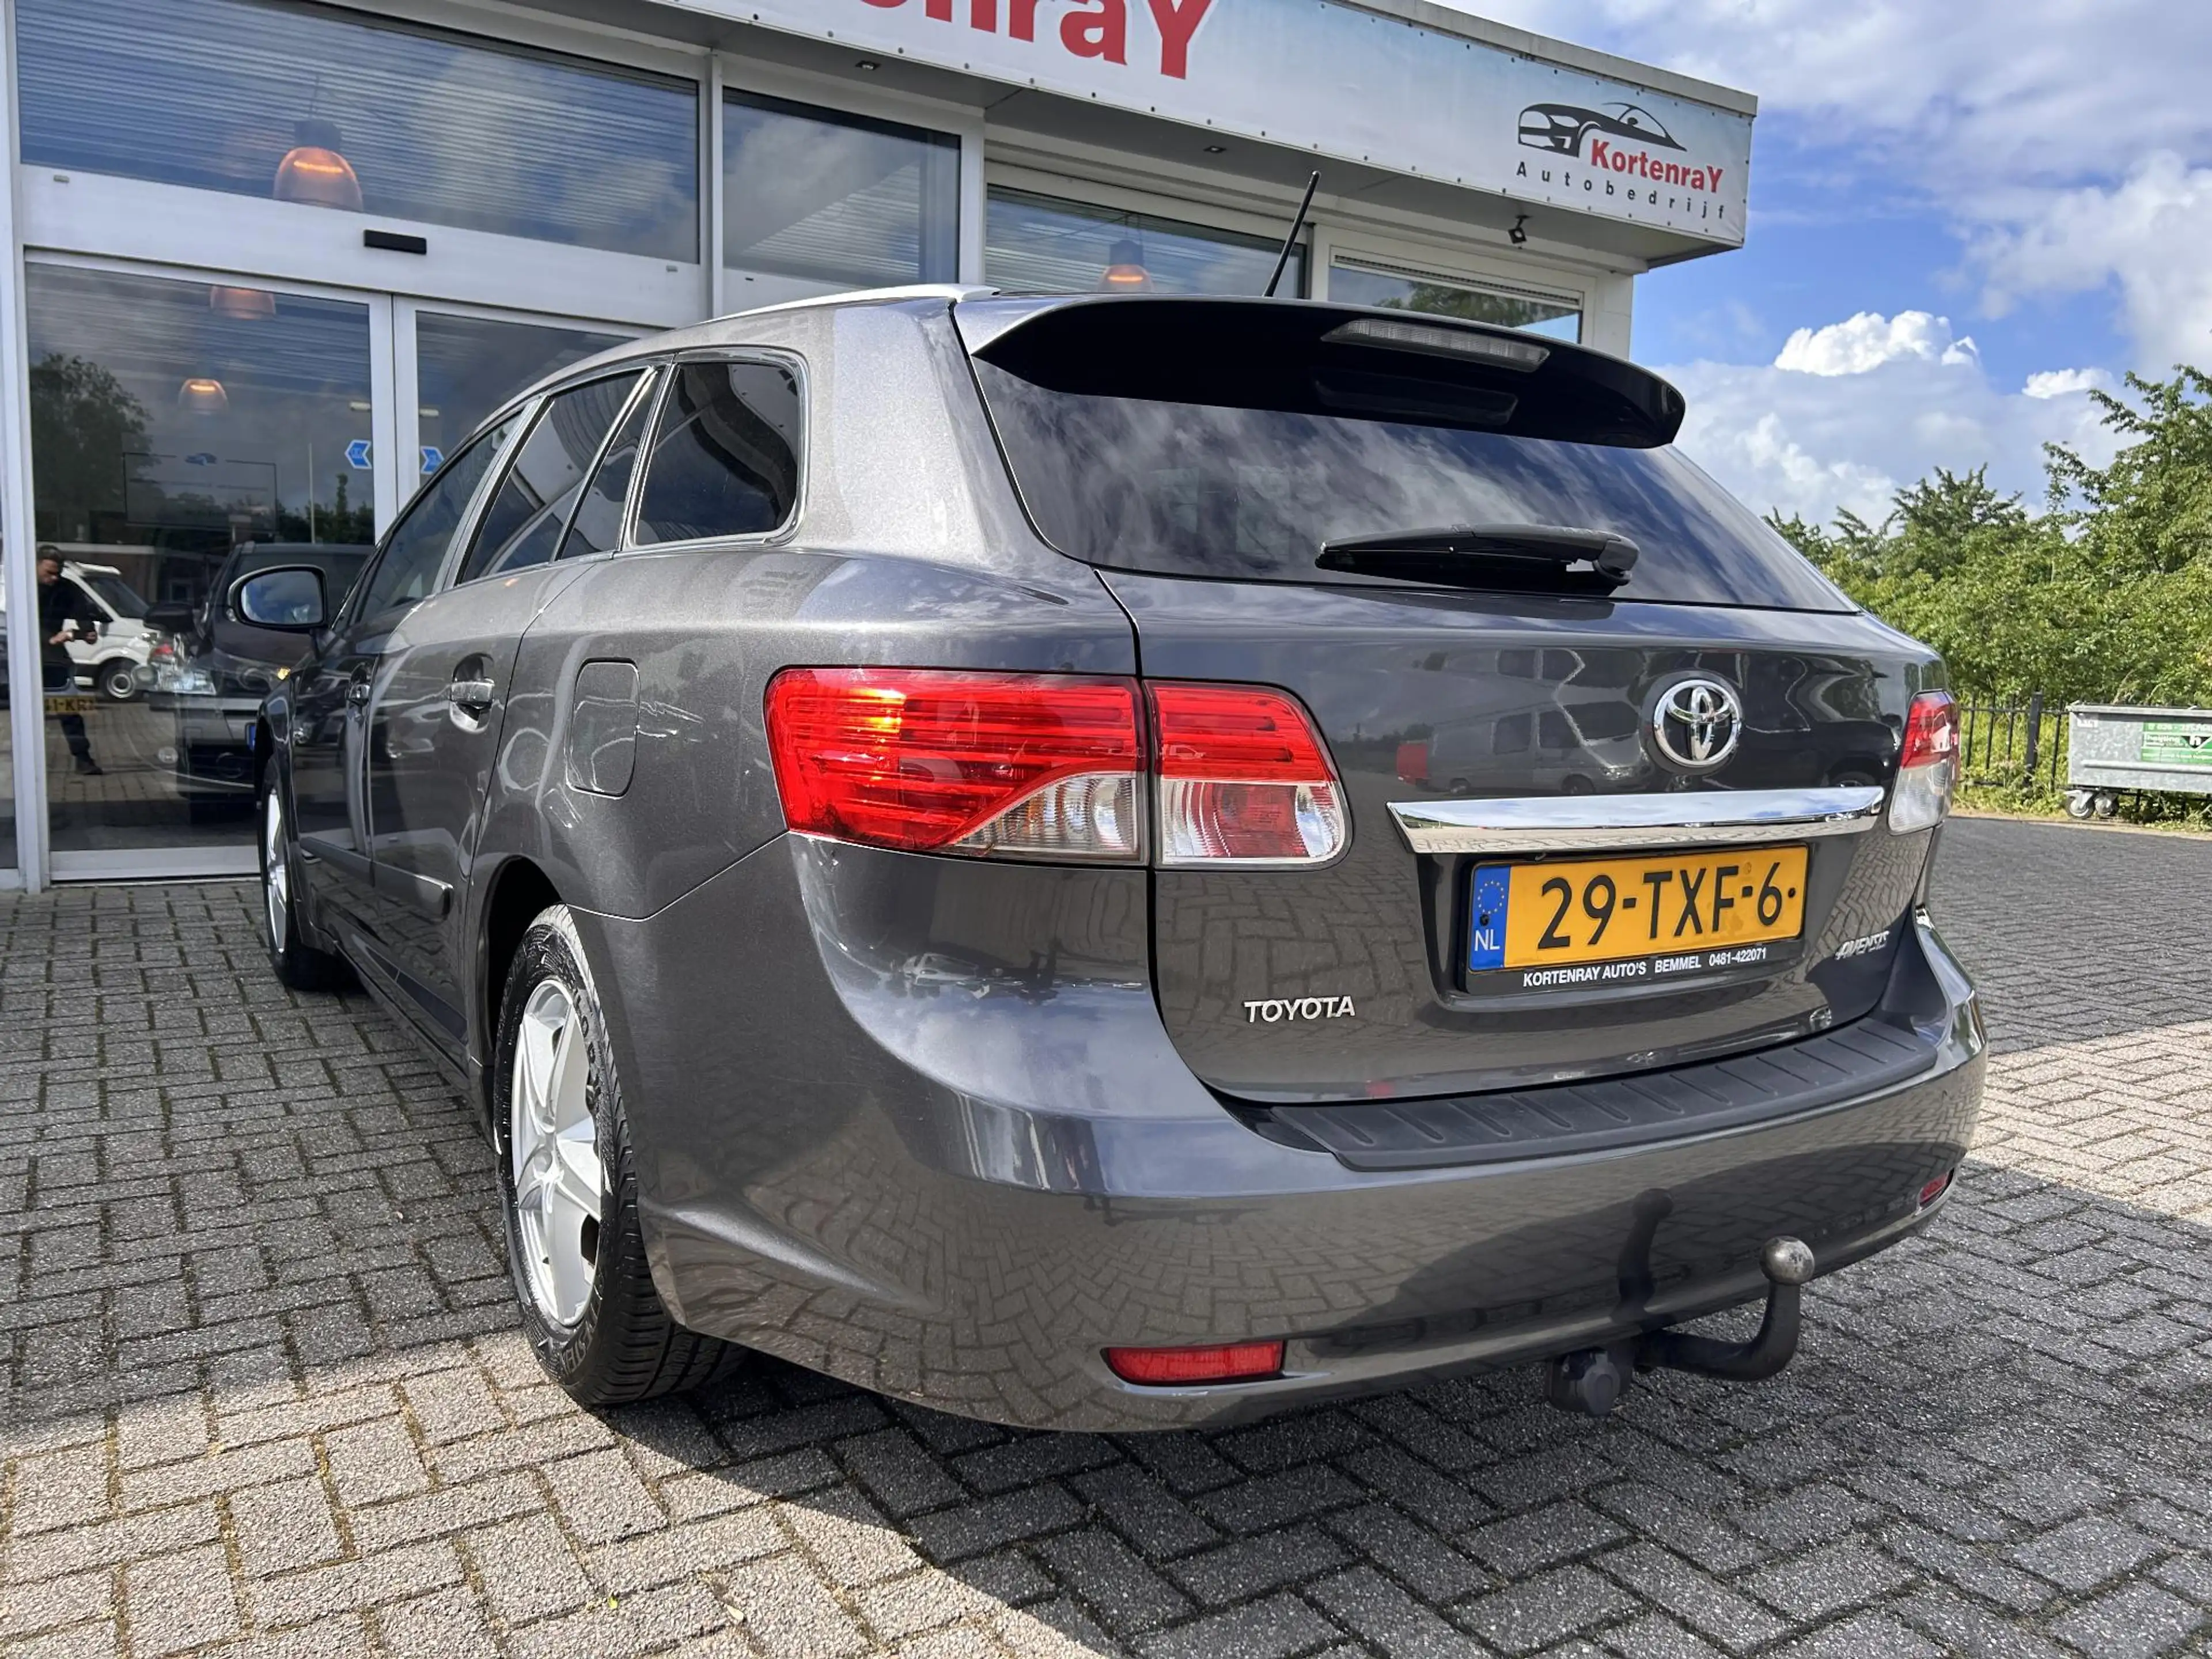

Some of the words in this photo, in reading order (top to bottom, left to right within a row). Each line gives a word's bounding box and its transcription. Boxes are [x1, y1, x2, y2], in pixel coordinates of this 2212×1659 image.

[1591, 138, 1724, 193] KortenraY
[1516, 161, 1725, 219] Autobedrijf
[1537, 862, 1782, 950] 29-TXF-6
[1474, 929, 1500, 951] NL
[1522, 968, 1599, 987] KORTENRAY
[1603, 961, 1647, 980] AUTO'S
[1654, 956, 1702, 974] BEMMEL
[1709, 946, 1768, 967] 0481-422071
[1244, 995, 1356, 1023] TOYOTA
